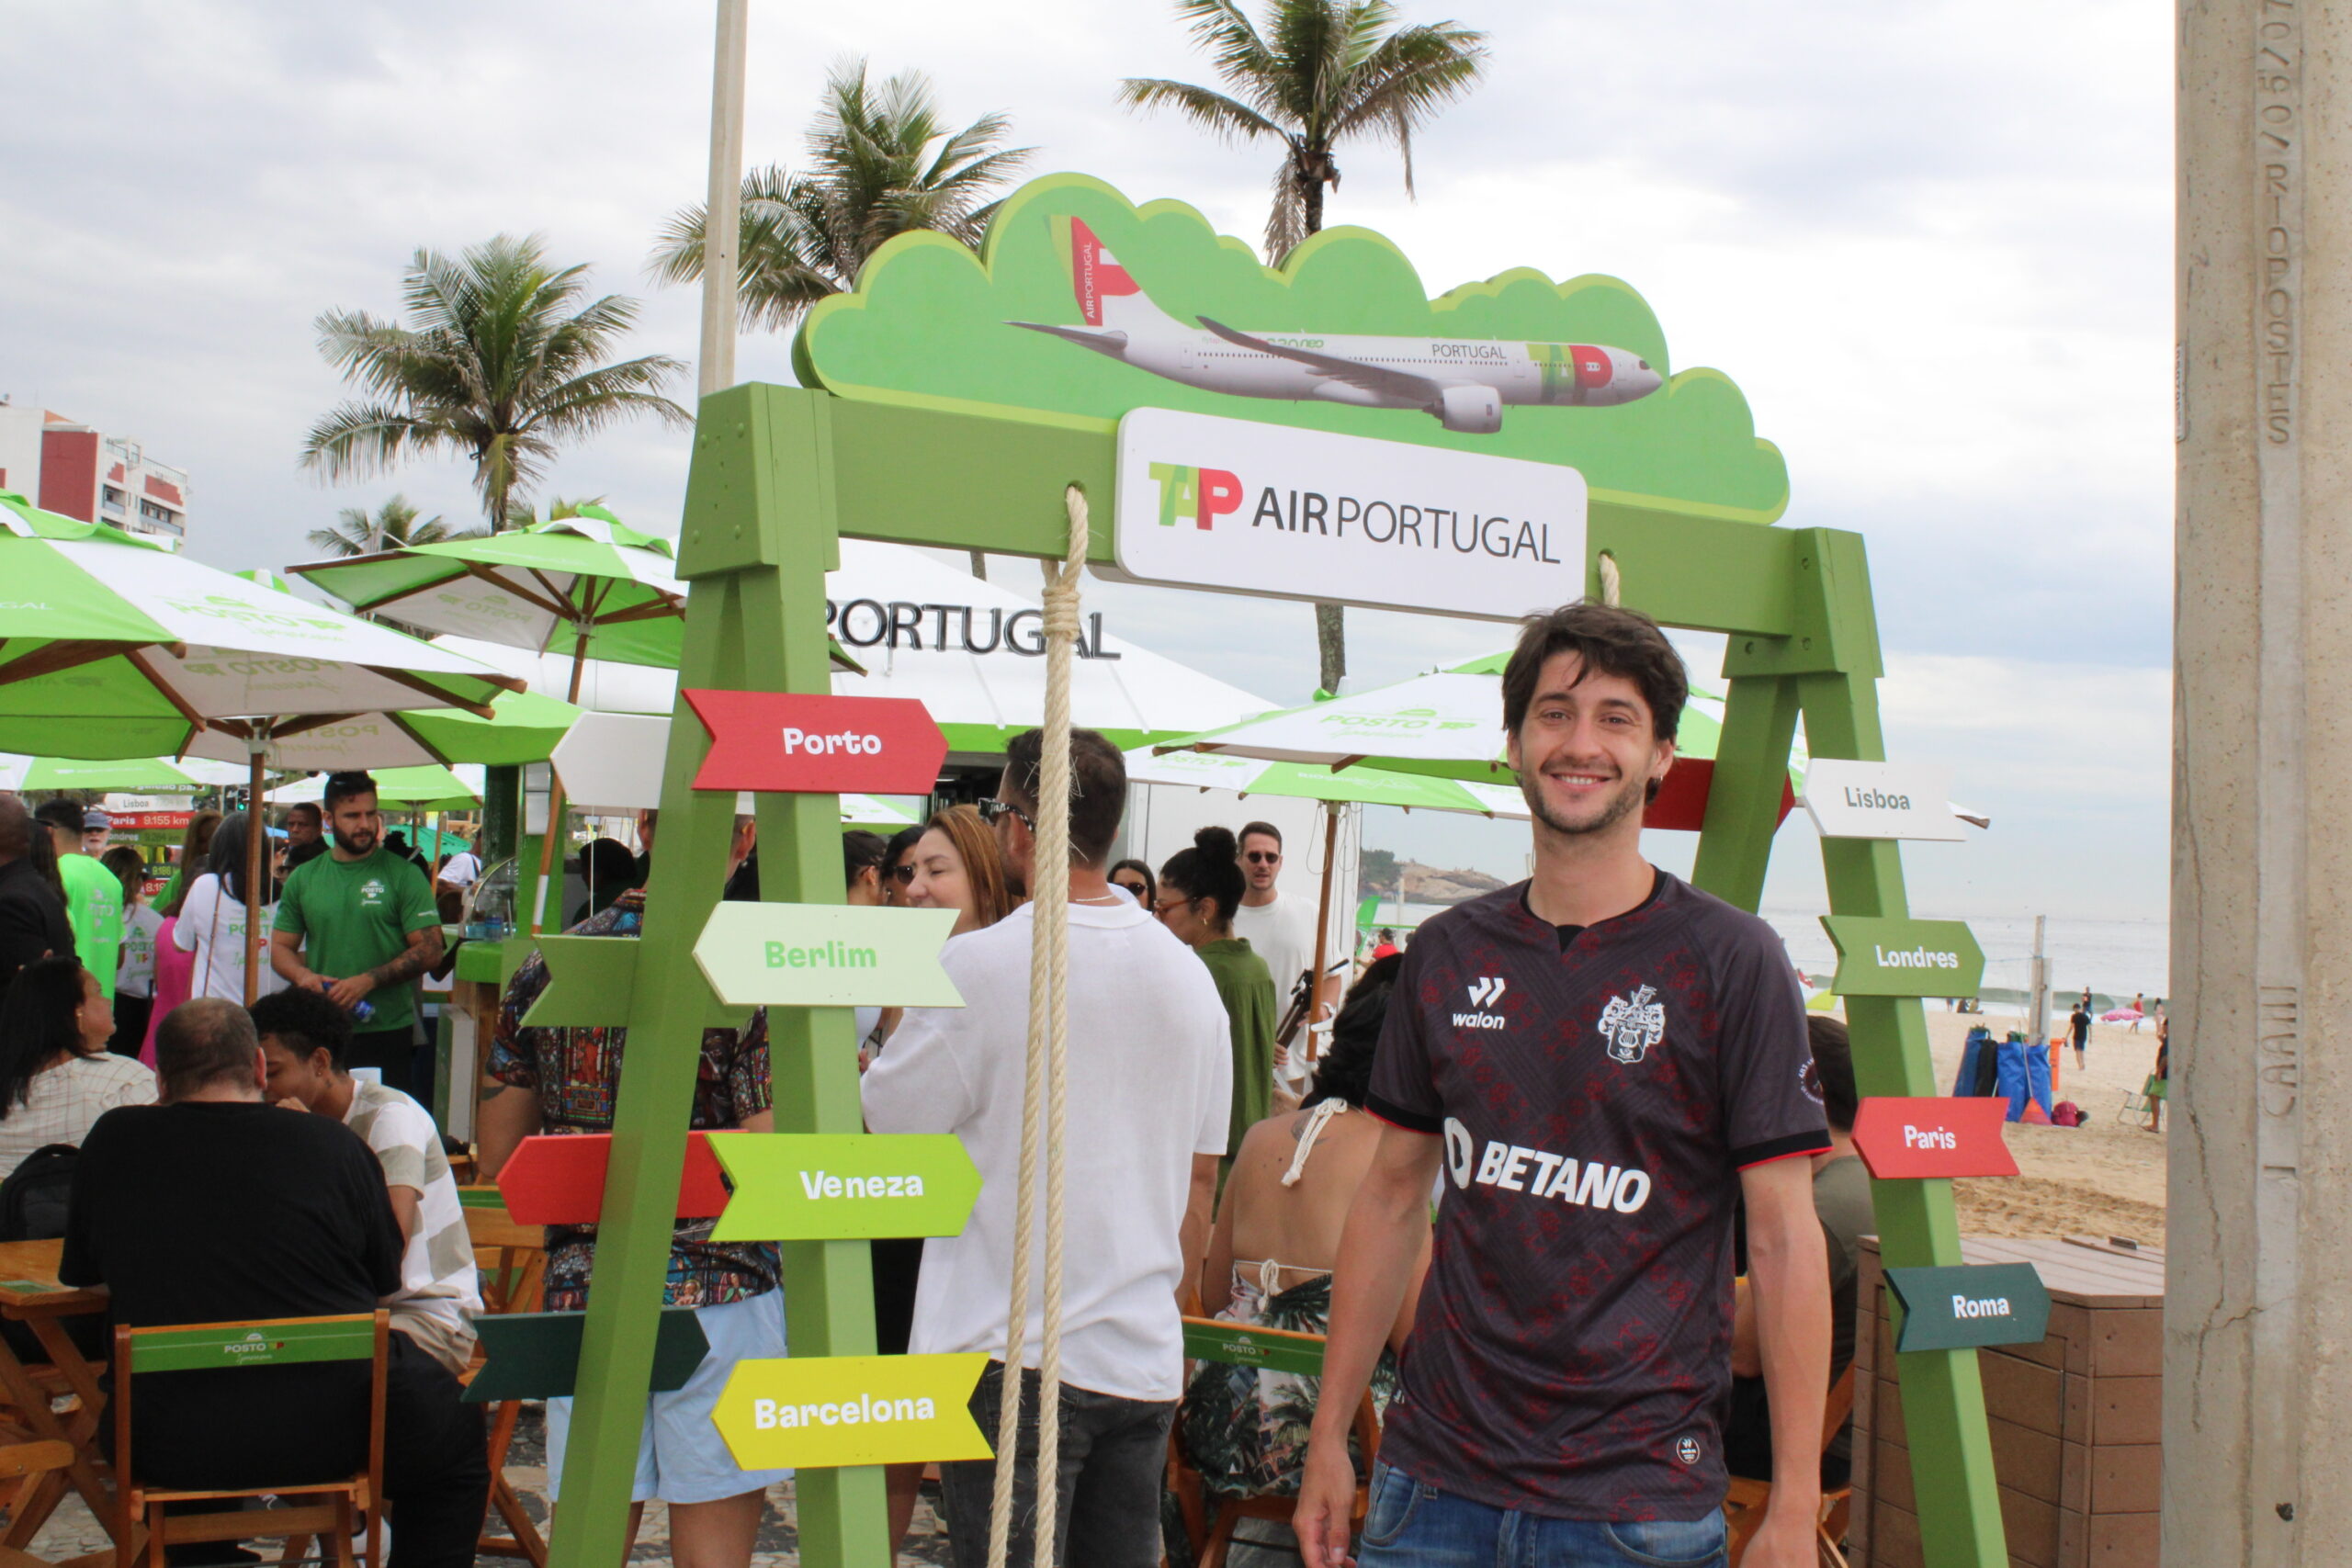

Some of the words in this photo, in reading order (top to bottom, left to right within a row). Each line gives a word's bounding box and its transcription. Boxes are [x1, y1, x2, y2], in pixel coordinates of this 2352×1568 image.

[1083, 242, 1093, 299] PORTUGAL
[1086, 299, 1095, 319] AIR
[1431, 344, 1507, 359] PORTUGAL
[1148, 461, 1243, 531] TAP
[1252, 486, 1329, 536] AIR
[1338, 496, 1562, 564] PORTUGAL
[1319, 714, 1430, 729] POSTO
[783, 728, 882, 755] Porto
[123, 799, 149, 807] Lisboa
[1844, 786, 1911, 810] Lisboa
[173, 815, 189, 825] km
[108, 831, 140, 841] ondres
[764, 940, 877, 968] Berlim
[1875, 944, 1959, 969] Londres
[1452, 1011, 1506, 1030] walon
[1904, 1124, 1957, 1149] Paris
[799, 1170, 924, 1200] Veneza
[1476, 1140, 1651, 1213] BETANO
[1951, 1294, 2010, 1319] Roma
[224, 1342, 266, 1354] POSTO
[1222, 1342, 1257, 1356] POSTO
[754, 1393, 935, 1429] Barcelona
